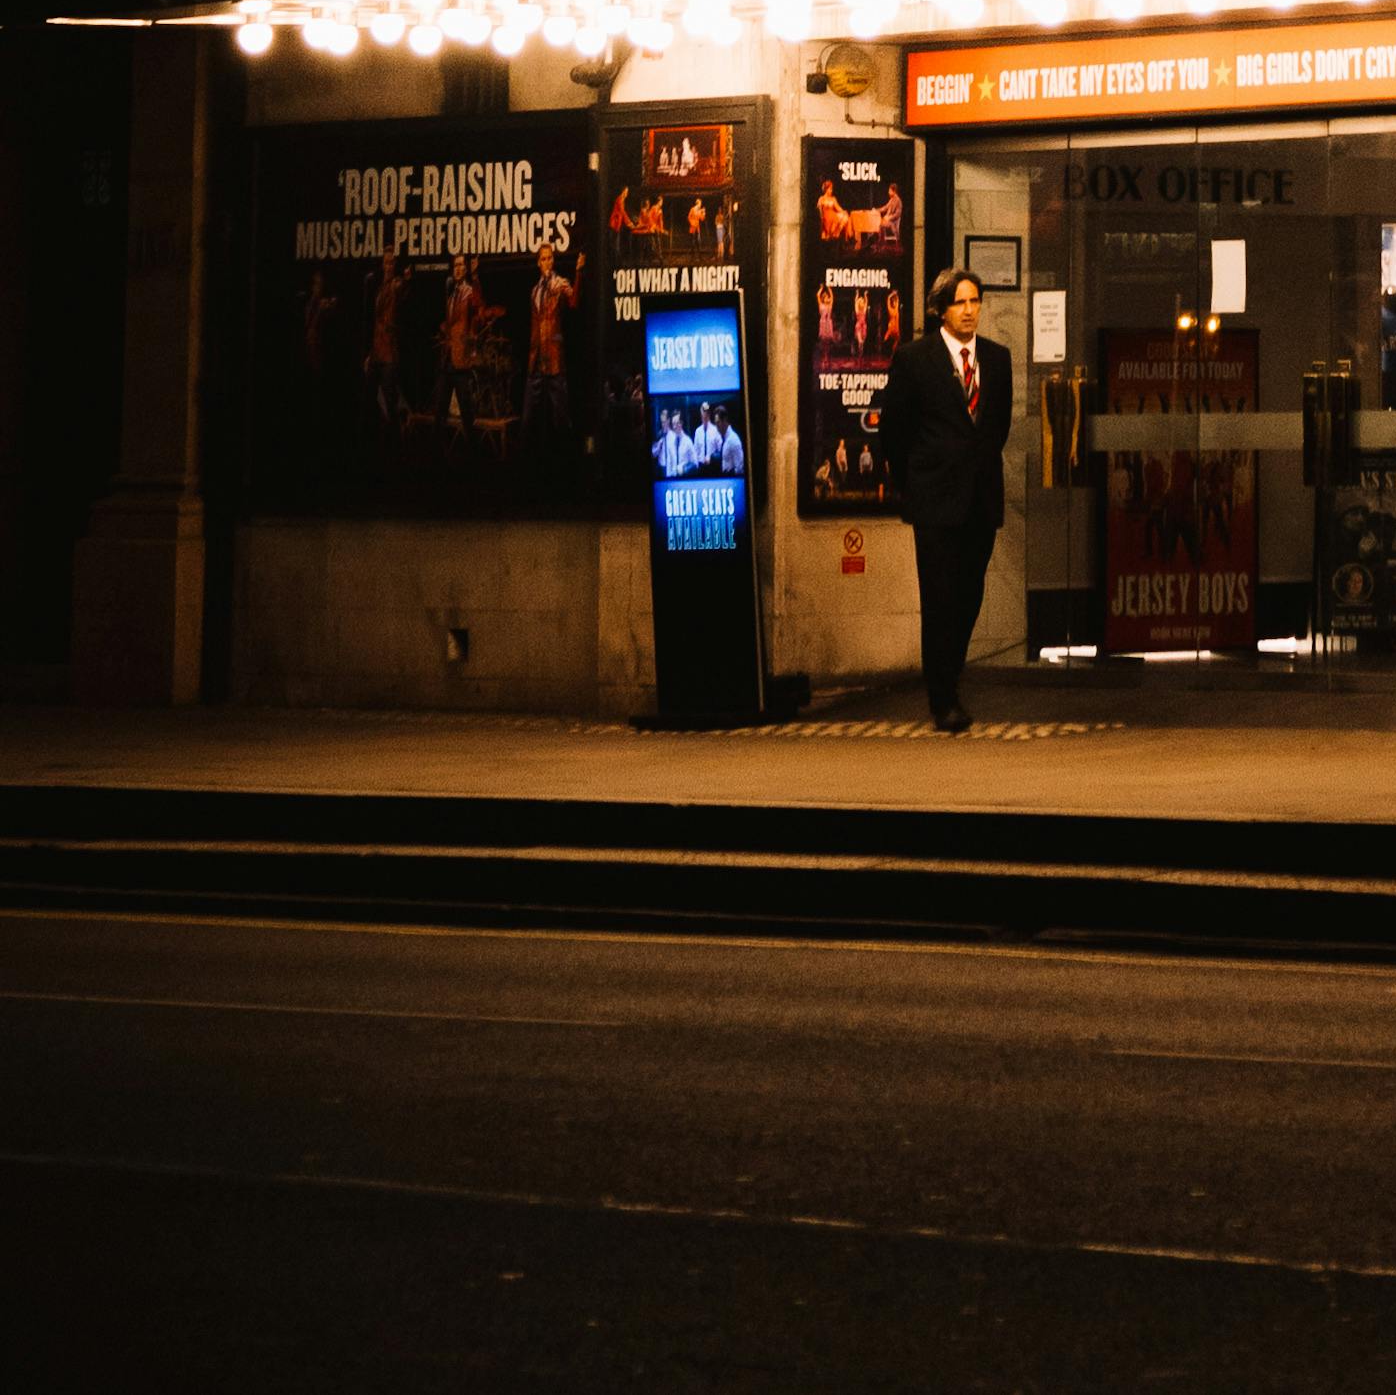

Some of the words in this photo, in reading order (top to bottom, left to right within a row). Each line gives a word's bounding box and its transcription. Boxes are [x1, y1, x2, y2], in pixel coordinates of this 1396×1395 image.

[916, 72, 974, 106] BEGGIN'
[1040, 65, 1078, 99] TAKE
[1079, 64, 1105, 97] MY
[1106, 61, 1145, 95] EYES
[1147, 59, 1176, 93] OFF
[1177, 57, 1209, 90] YOU
[1236, 52, 1264, 87] BIG
[1265, 50, 1312, 86] GIRLS
[1314, 47, 1364, 83] DON'T
[337, 159, 534, 217] 'ROOF-RAISING
[838, 161, 881, 182] 'SLICK,
[1063, 164, 1145, 202] BOX
[1158, 165, 1298, 206] OFFICE
[296, 218, 385, 260] MUSICAL
[393, 210, 577, 257] PERFORMANCES'
[638, 266, 679, 294] WHAT
[680, 265, 691, 293] A
[692, 264, 740, 292] NIGHT!
[825, 268, 891, 289] ENGAGING,
[614, 296, 642, 321] YOU
[651, 334, 699, 371] JERSEY
[701, 333, 735, 369] BOYS
[665, 489, 698, 518] GREAT
[701, 488, 735, 516] SEATS
[668, 516, 737, 551] AVAILABLE
[1111, 572, 1191, 617] JERSEY
[1198, 570, 1249, 615] BOYS
